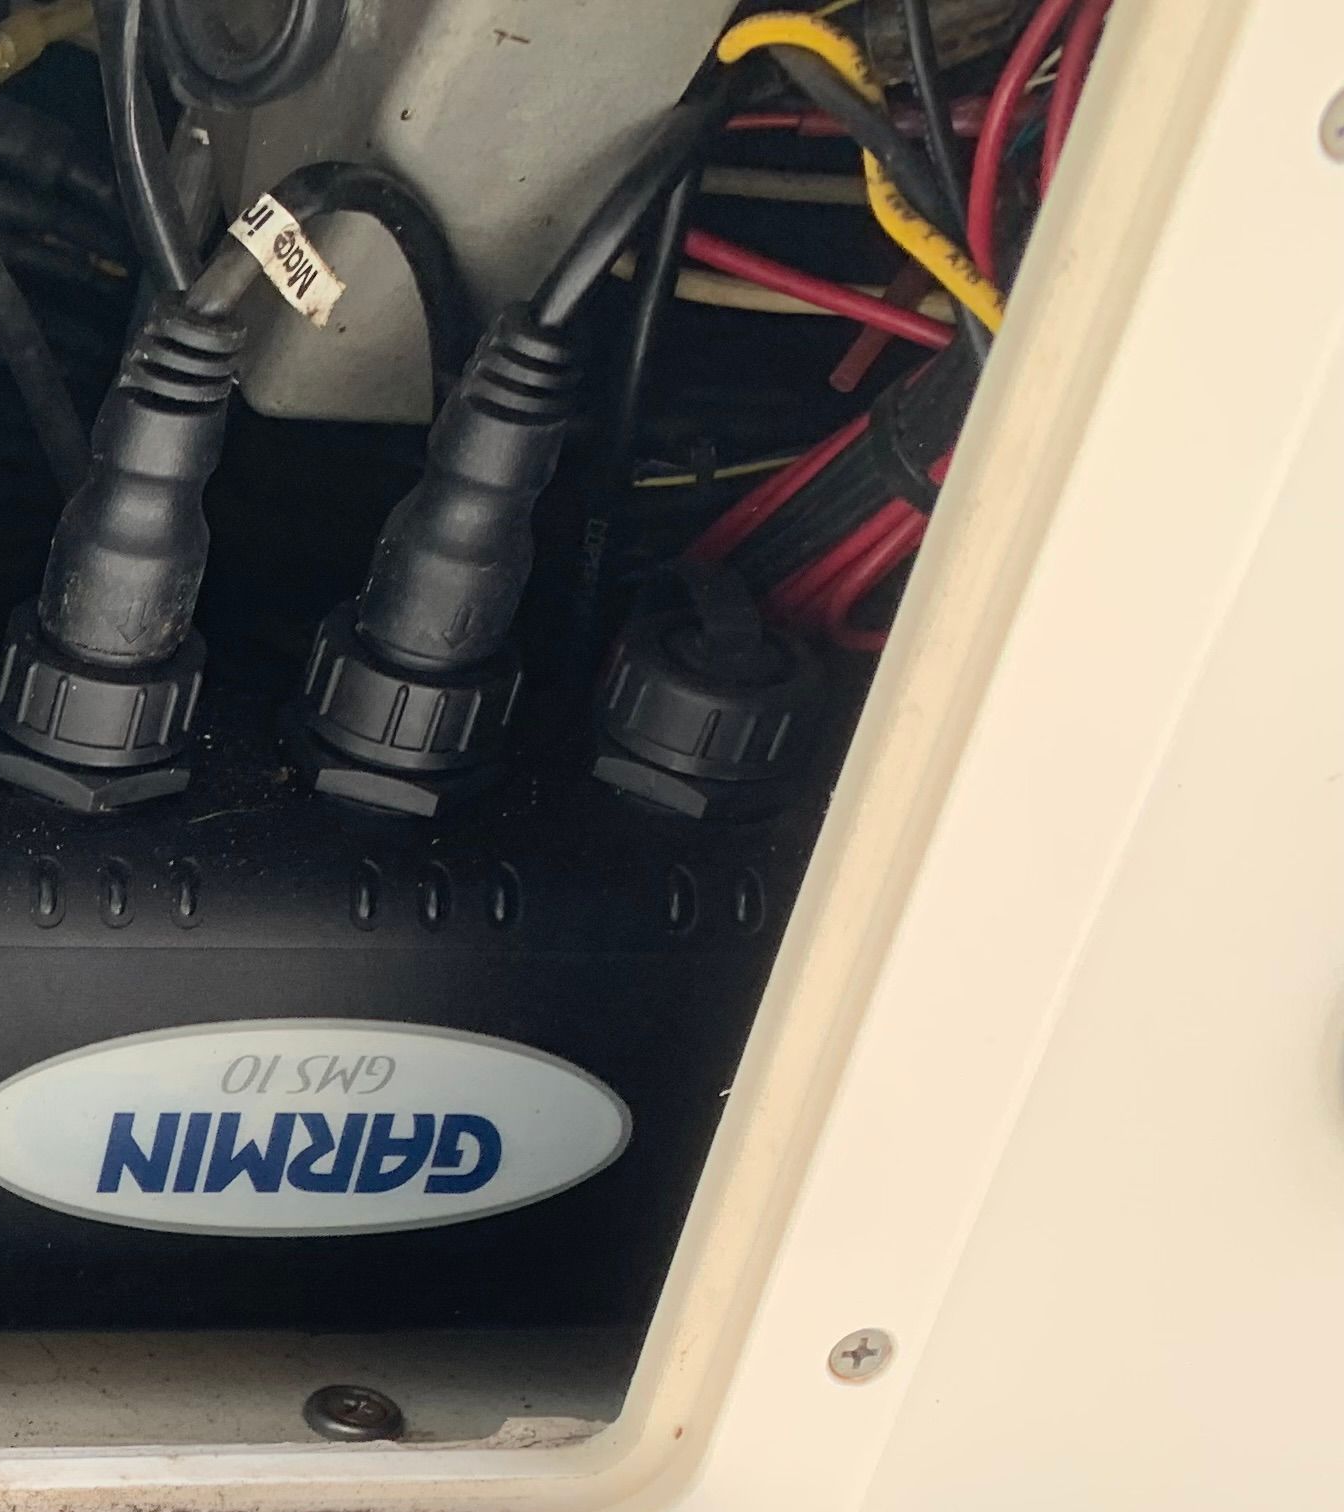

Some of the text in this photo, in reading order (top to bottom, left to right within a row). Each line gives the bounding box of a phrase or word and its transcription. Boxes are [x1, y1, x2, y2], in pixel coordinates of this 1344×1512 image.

[221, 1054, 397, 1095] GMS 10
[97, 1112, 503, 1195] GARMIN
